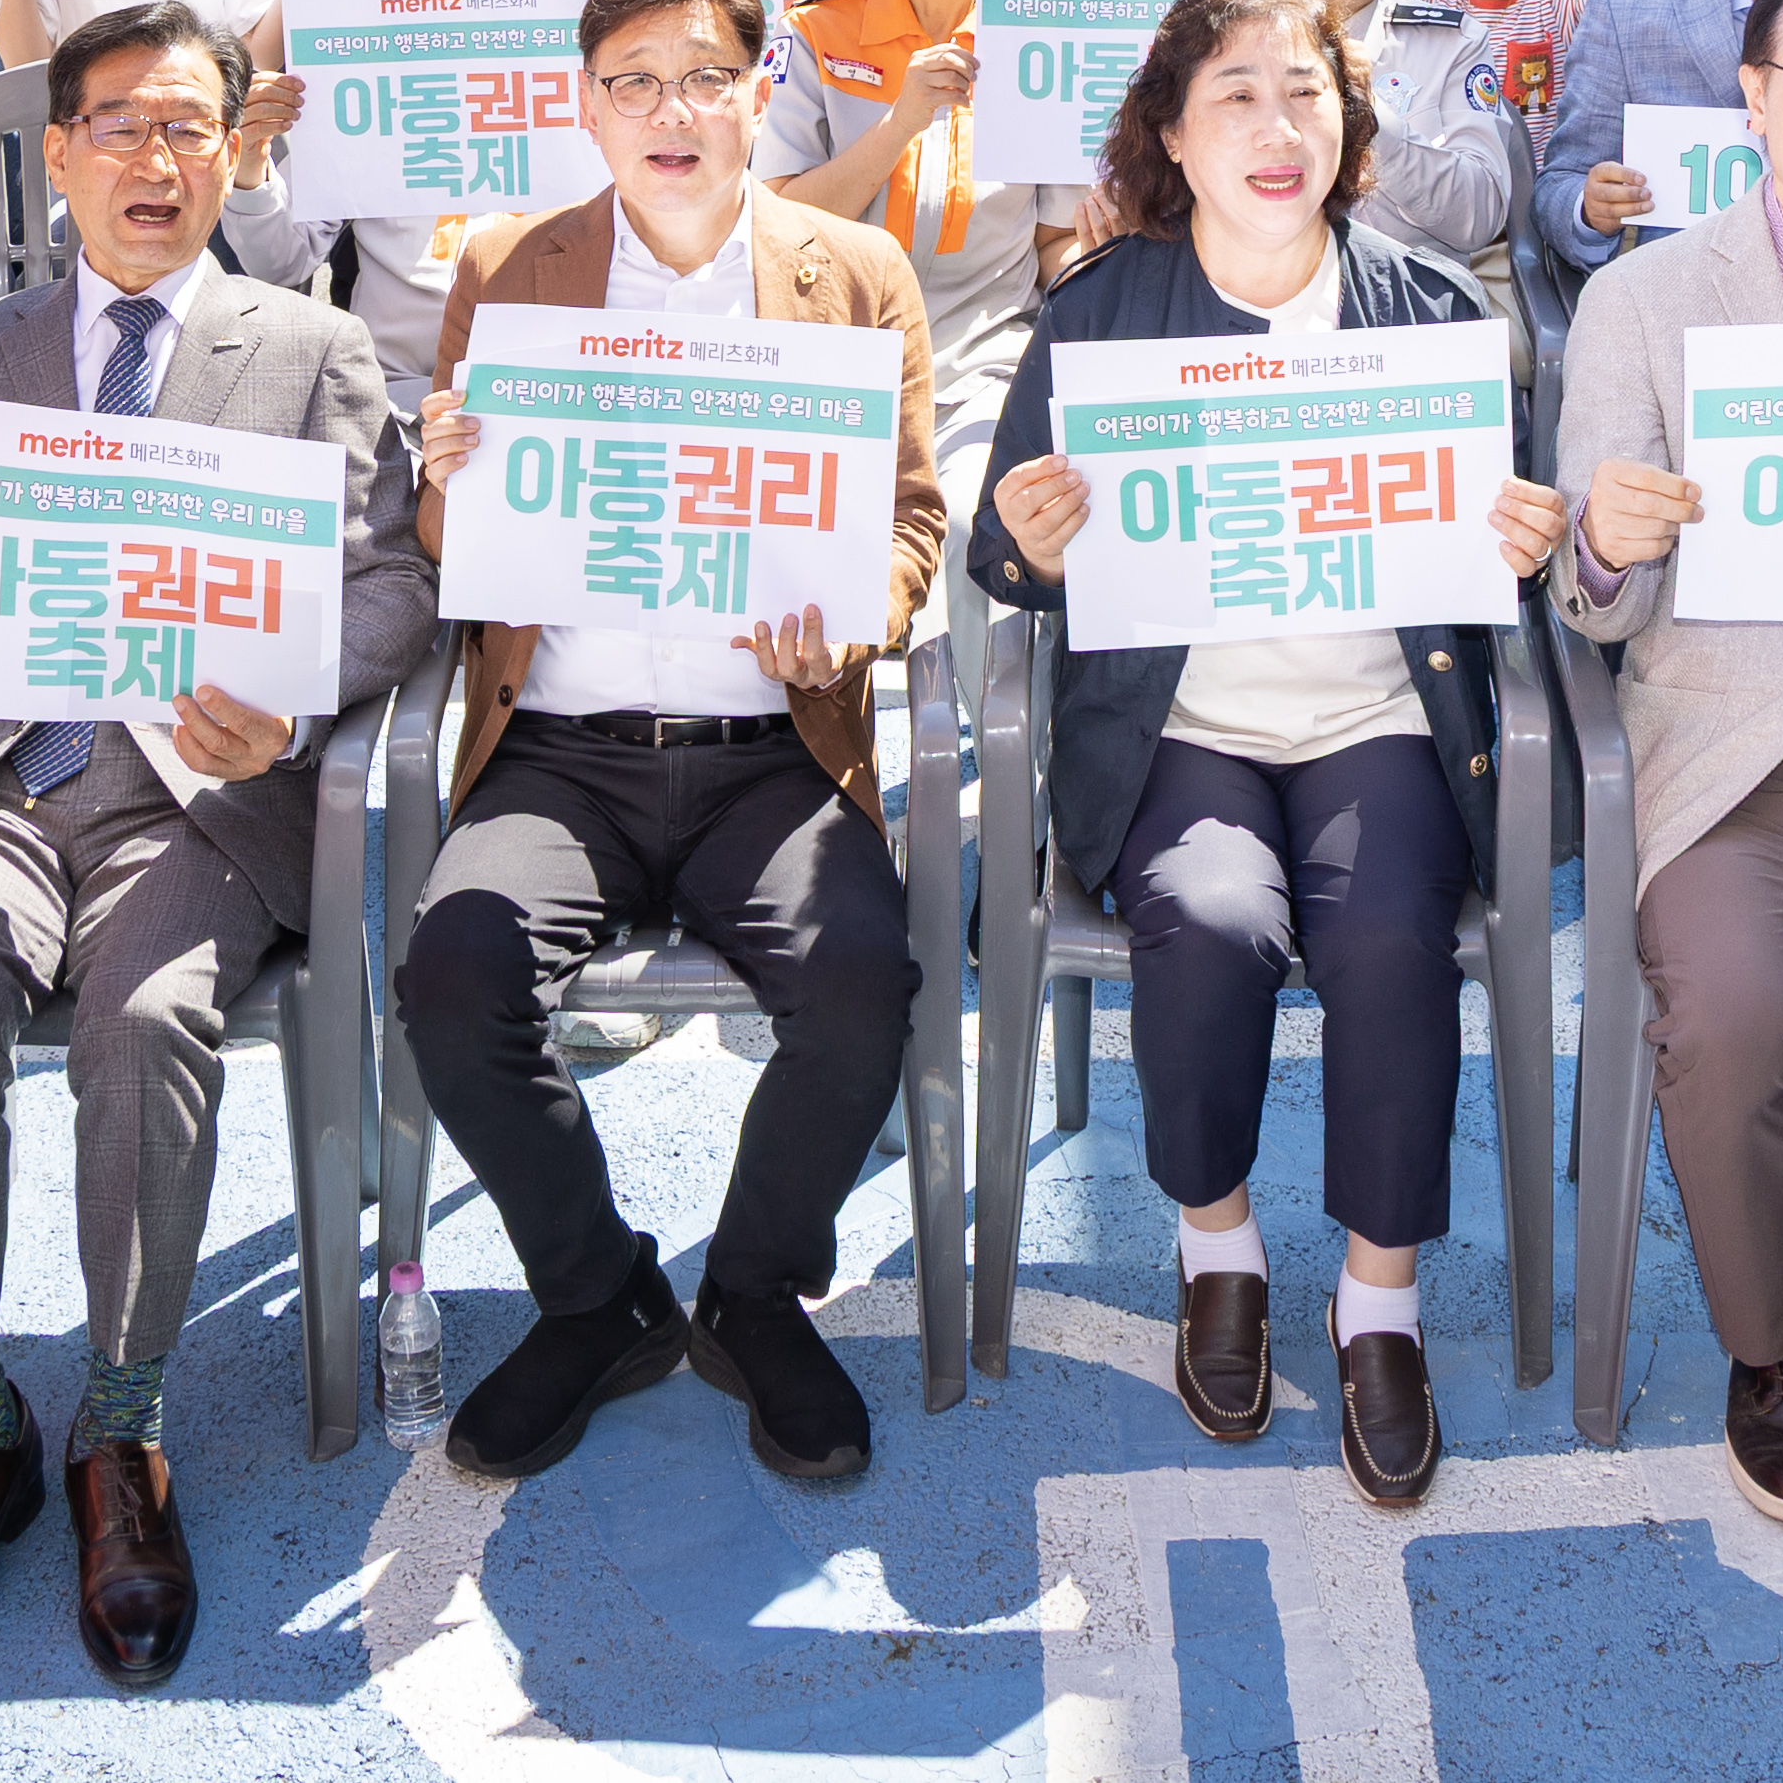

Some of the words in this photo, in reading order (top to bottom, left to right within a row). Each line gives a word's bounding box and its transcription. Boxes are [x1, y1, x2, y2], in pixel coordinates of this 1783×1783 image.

[579, 329, 683, 360] meritz
[689, 342, 779, 367] 메리츠화재
[1180, 352, 1285, 385] meritz
[1291, 353, 1384, 378] 메리츠화재
[490, 378, 586, 407] 어린이가
[591, 384, 683, 412] 행복하고
[689, 389, 762, 418] 안전한
[767, 394, 811, 419] 우리
[818, 397, 864, 426] 마을
[1094, 412, 1192, 441] 어린이가
[1196, 404, 1291, 435] 행복하고
[1297, 400, 1371, 429] 안전한
[1376, 397, 1421, 422] 우리
[1429, 391, 1475, 419] 마을
[19, 430, 123, 461] meritz
[130, 444, 220, 473] 메리츠화재
[29, 482, 125, 512] 행복하고
[130, 489, 204, 521] 안전한
[209, 498, 253, 526] 우리
[260, 505, 307, 536] 마을
[504, 436, 839, 532] 아동권리
[1119, 446, 1456, 543] 아동권리
[583, 525, 750, 615] 축제
[1209, 534, 1376, 616] 축제
[24, 621, 196, 703] 축제
